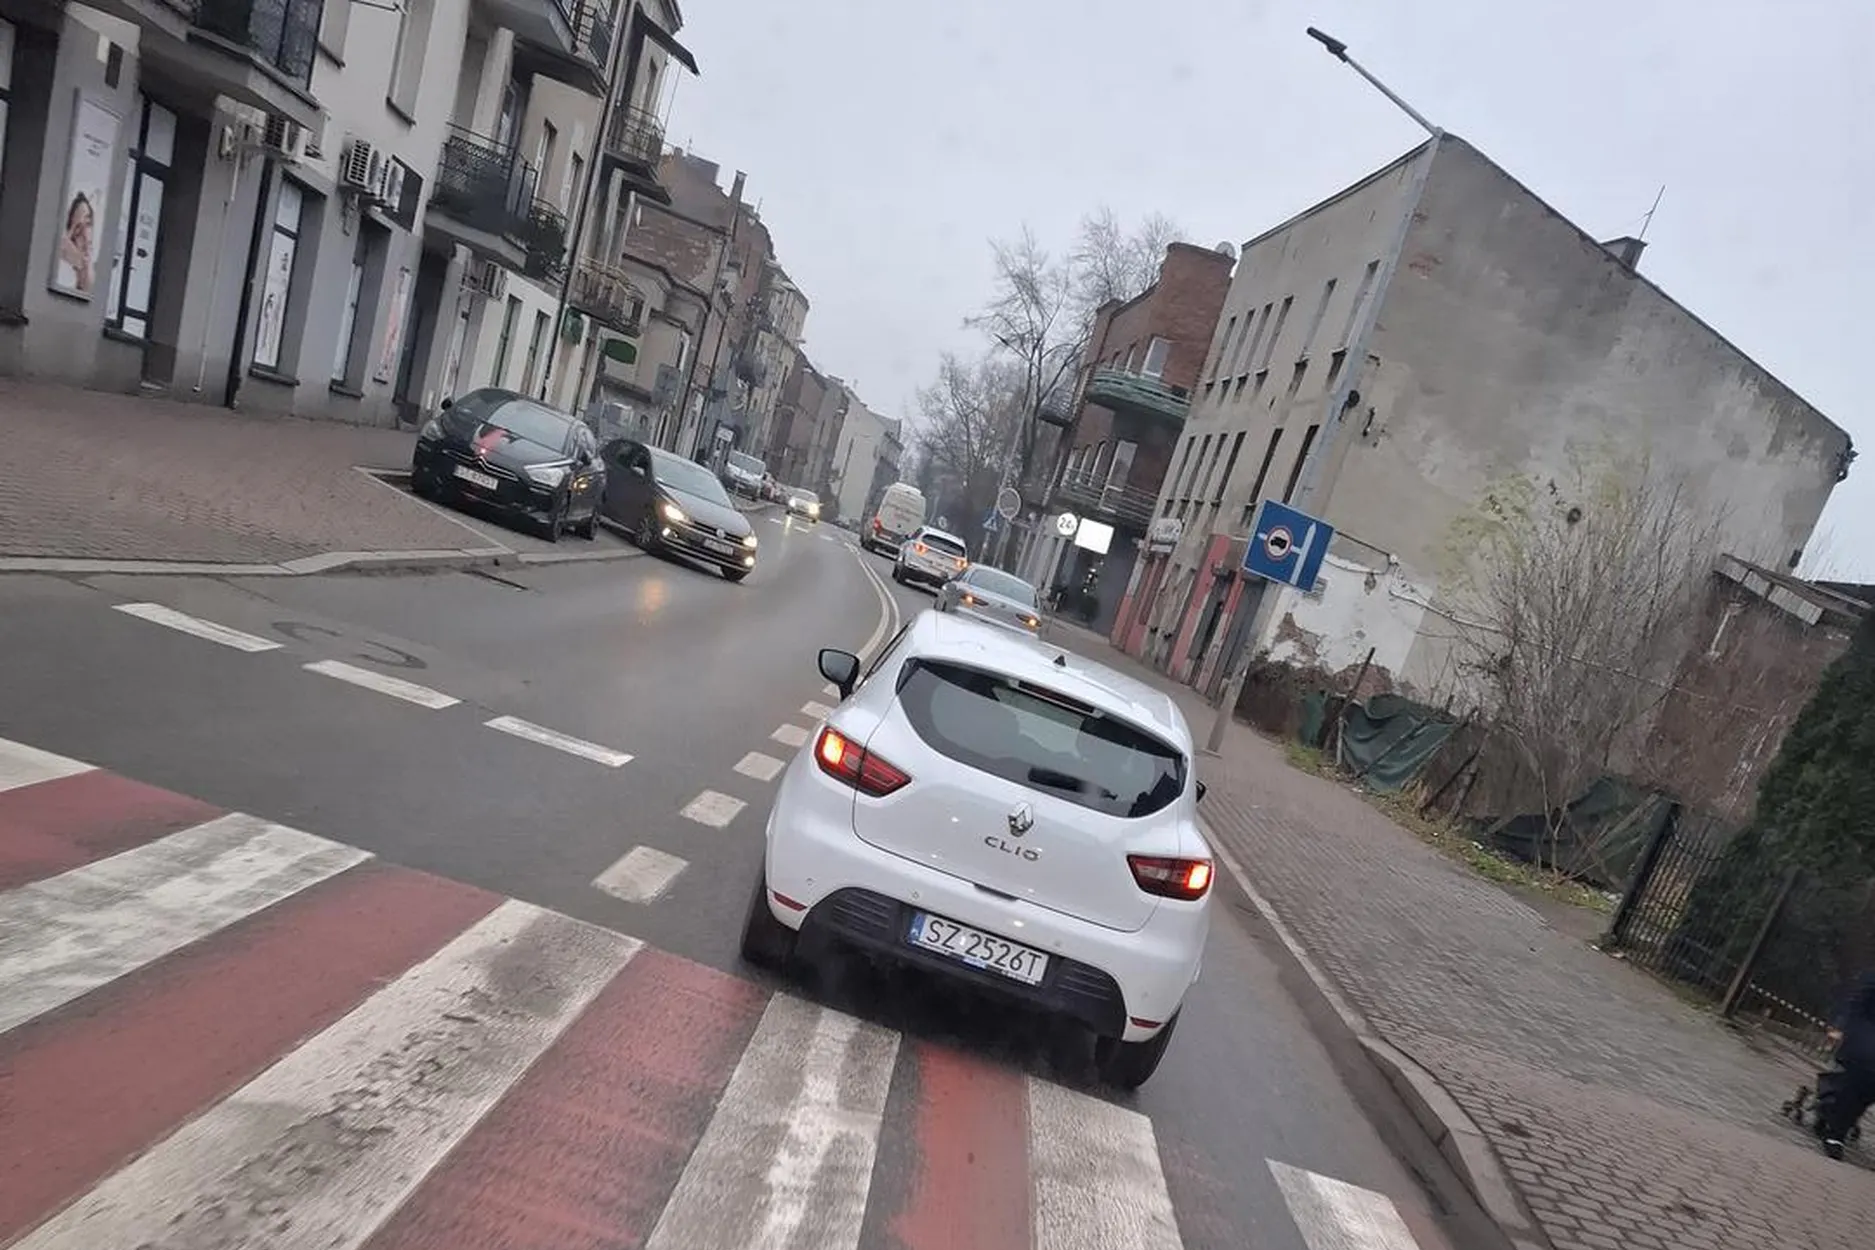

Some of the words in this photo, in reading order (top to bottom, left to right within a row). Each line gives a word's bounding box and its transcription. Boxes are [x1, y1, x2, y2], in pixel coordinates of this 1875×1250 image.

[984, 836, 1039, 861] CLIO
[926, 919, 962, 950] SZ
[965, 933, 1043, 977] 2526T
